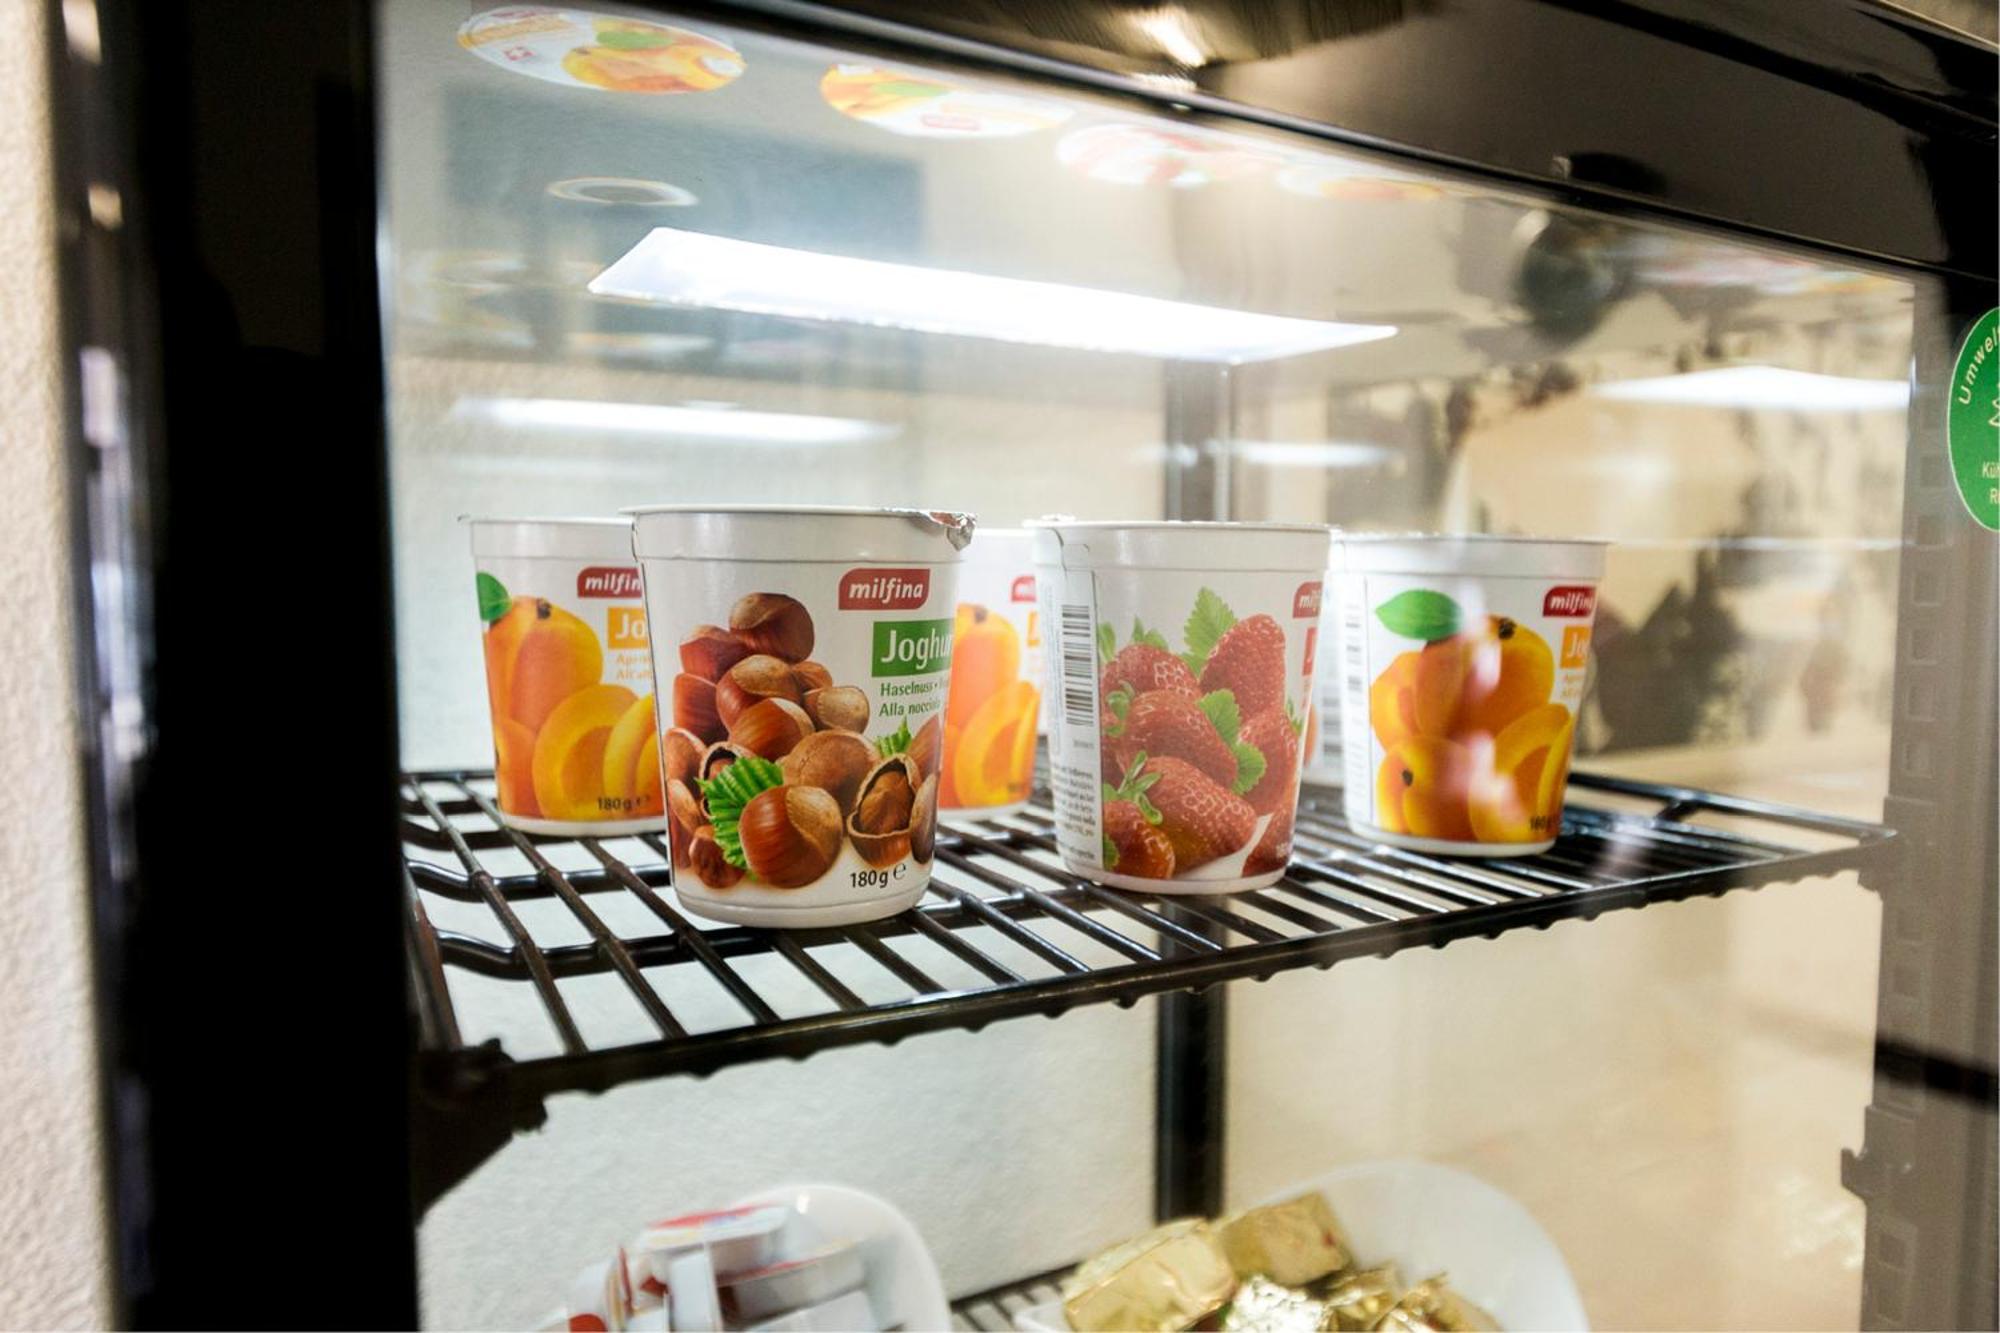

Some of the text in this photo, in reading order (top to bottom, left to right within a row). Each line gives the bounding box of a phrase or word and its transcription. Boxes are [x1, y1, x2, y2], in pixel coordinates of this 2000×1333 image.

[1959, 325, 2000, 404] Umwel
[584, 572, 642, 595] milfin
[849, 577, 924, 604] milfina
[615, 612, 646, 640] Jo
[880, 681, 935, 697] Haselnuss
[879, 702, 905, 717] Alla
